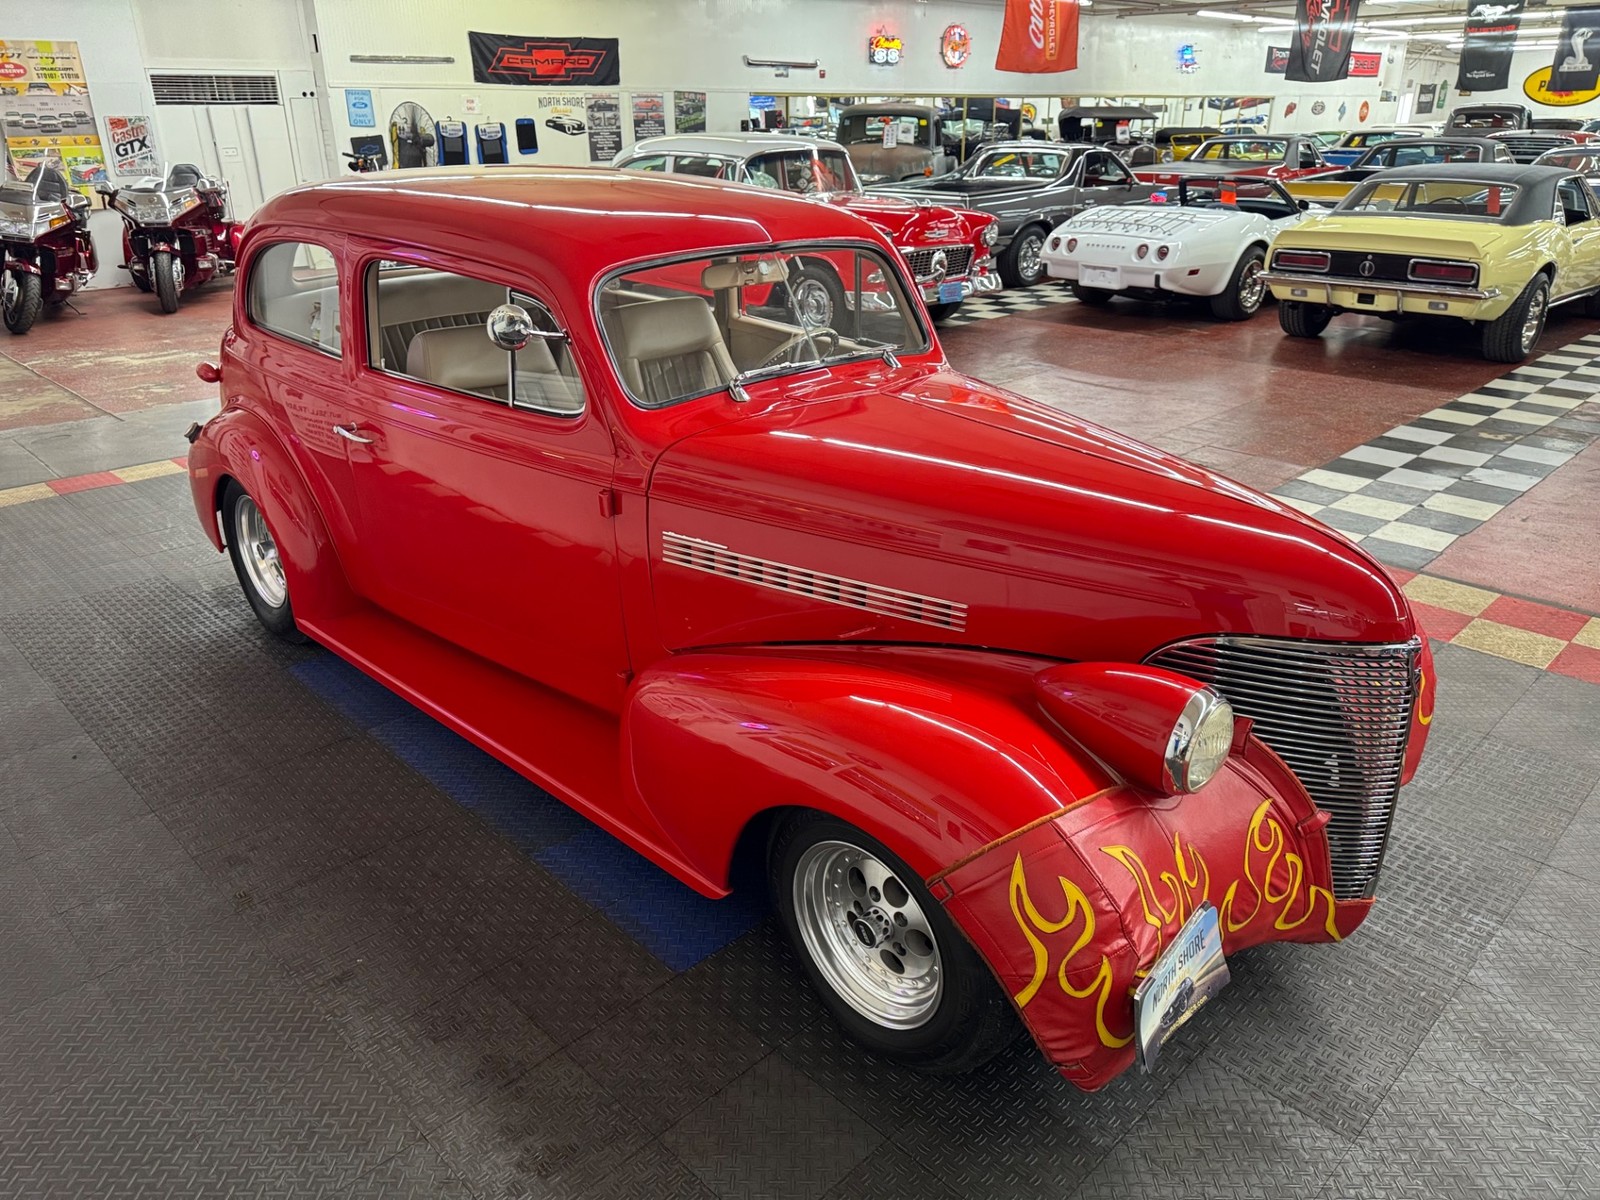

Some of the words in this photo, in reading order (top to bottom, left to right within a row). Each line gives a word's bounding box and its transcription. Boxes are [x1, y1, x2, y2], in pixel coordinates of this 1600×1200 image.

[507, 57, 590, 66] CAMARO
[538, 96, 561, 109] NORTH
[561, 96, 585, 109] SHORE
[115, 135, 151, 157] GTX
[1152, 962, 1177, 1012] NORTH
[1178, 929, 1207, 970] SHORE
